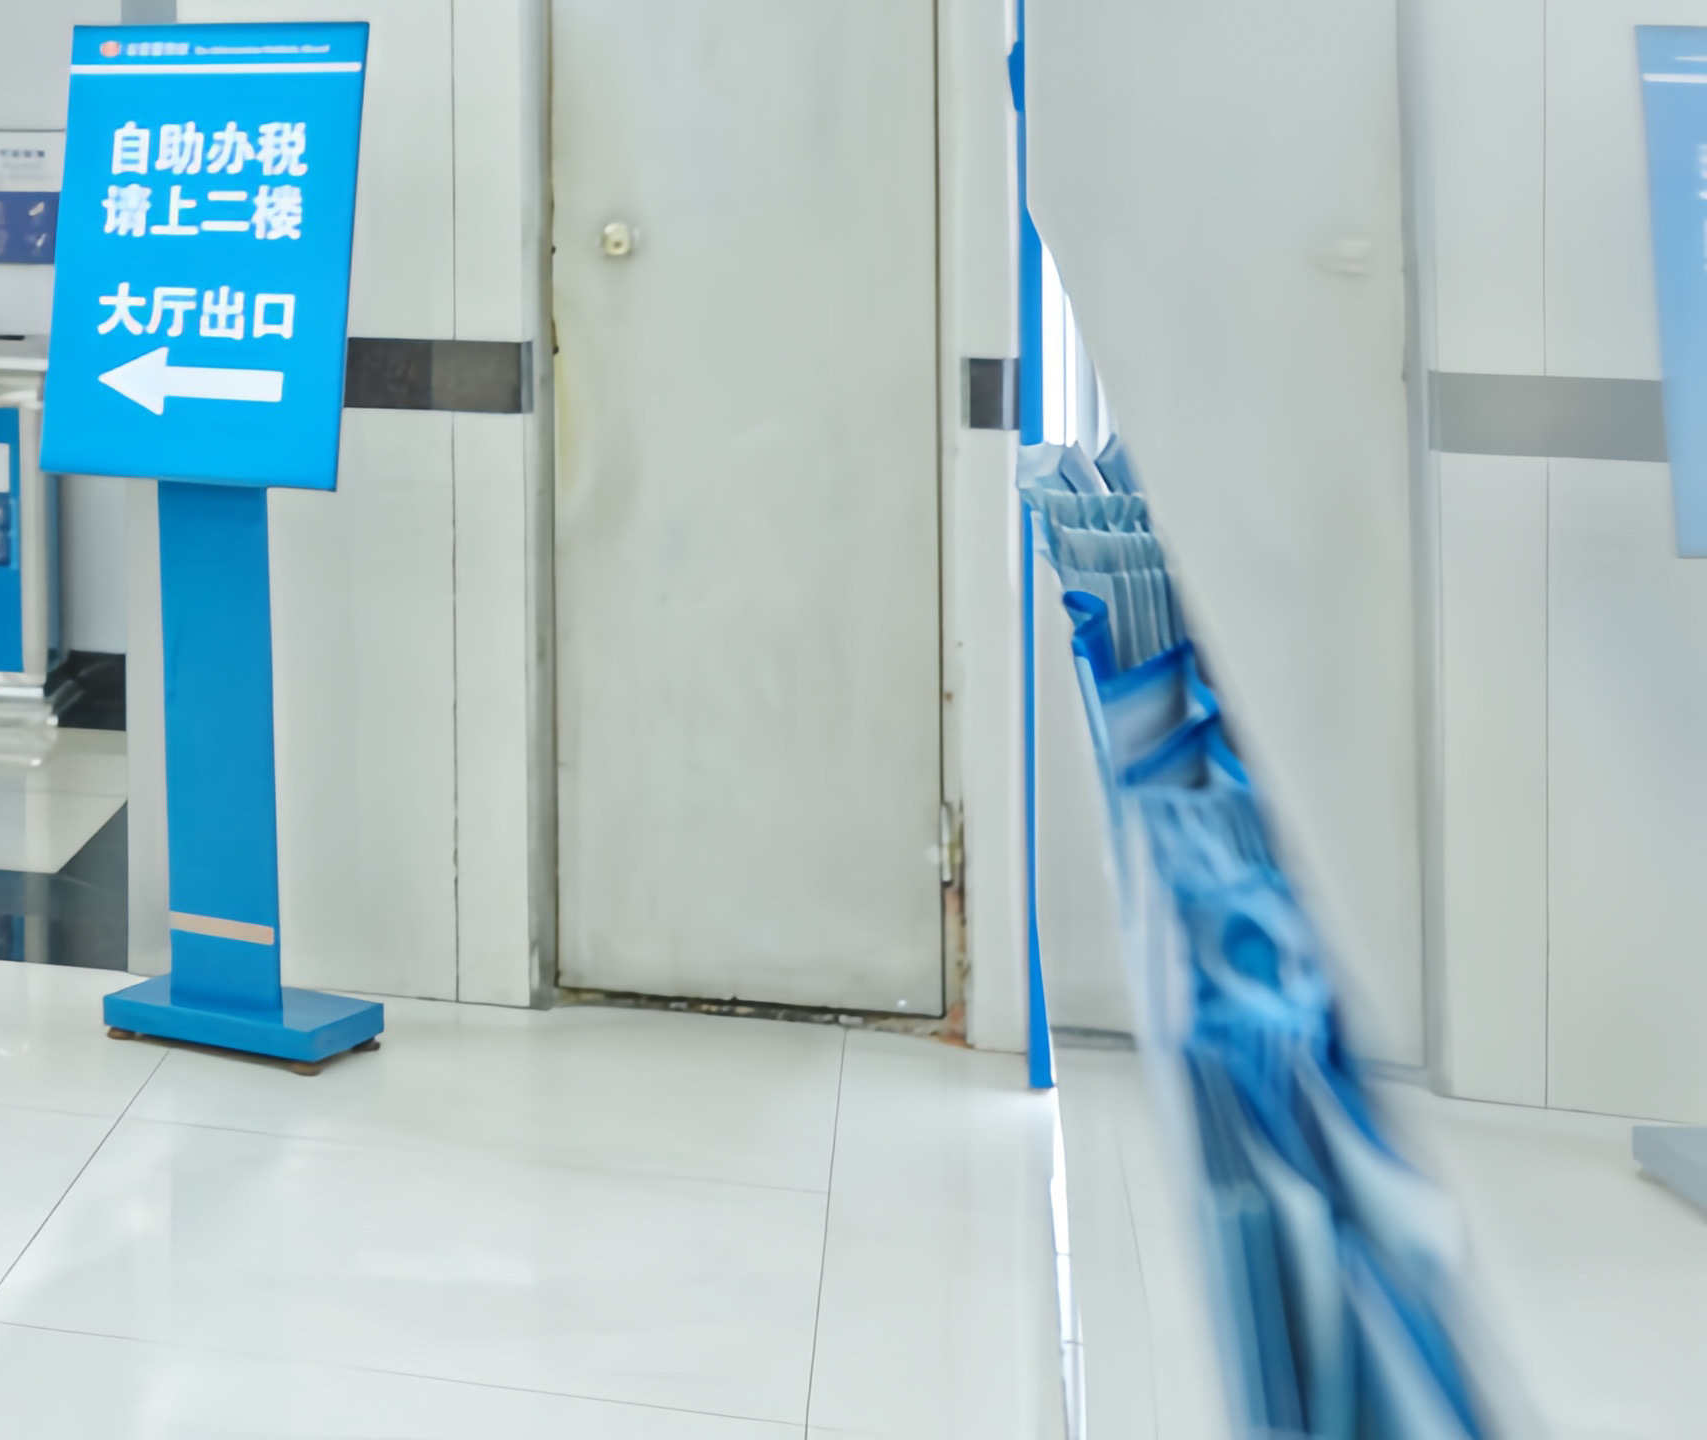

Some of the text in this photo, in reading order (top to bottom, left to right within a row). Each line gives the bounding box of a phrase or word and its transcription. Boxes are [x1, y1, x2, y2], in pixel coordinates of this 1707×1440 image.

[111, 120, 308, 176] 自助办税
[102, 183, 303, 239] 请上二楼
[97, 282, 296, 339] 大厅出口
